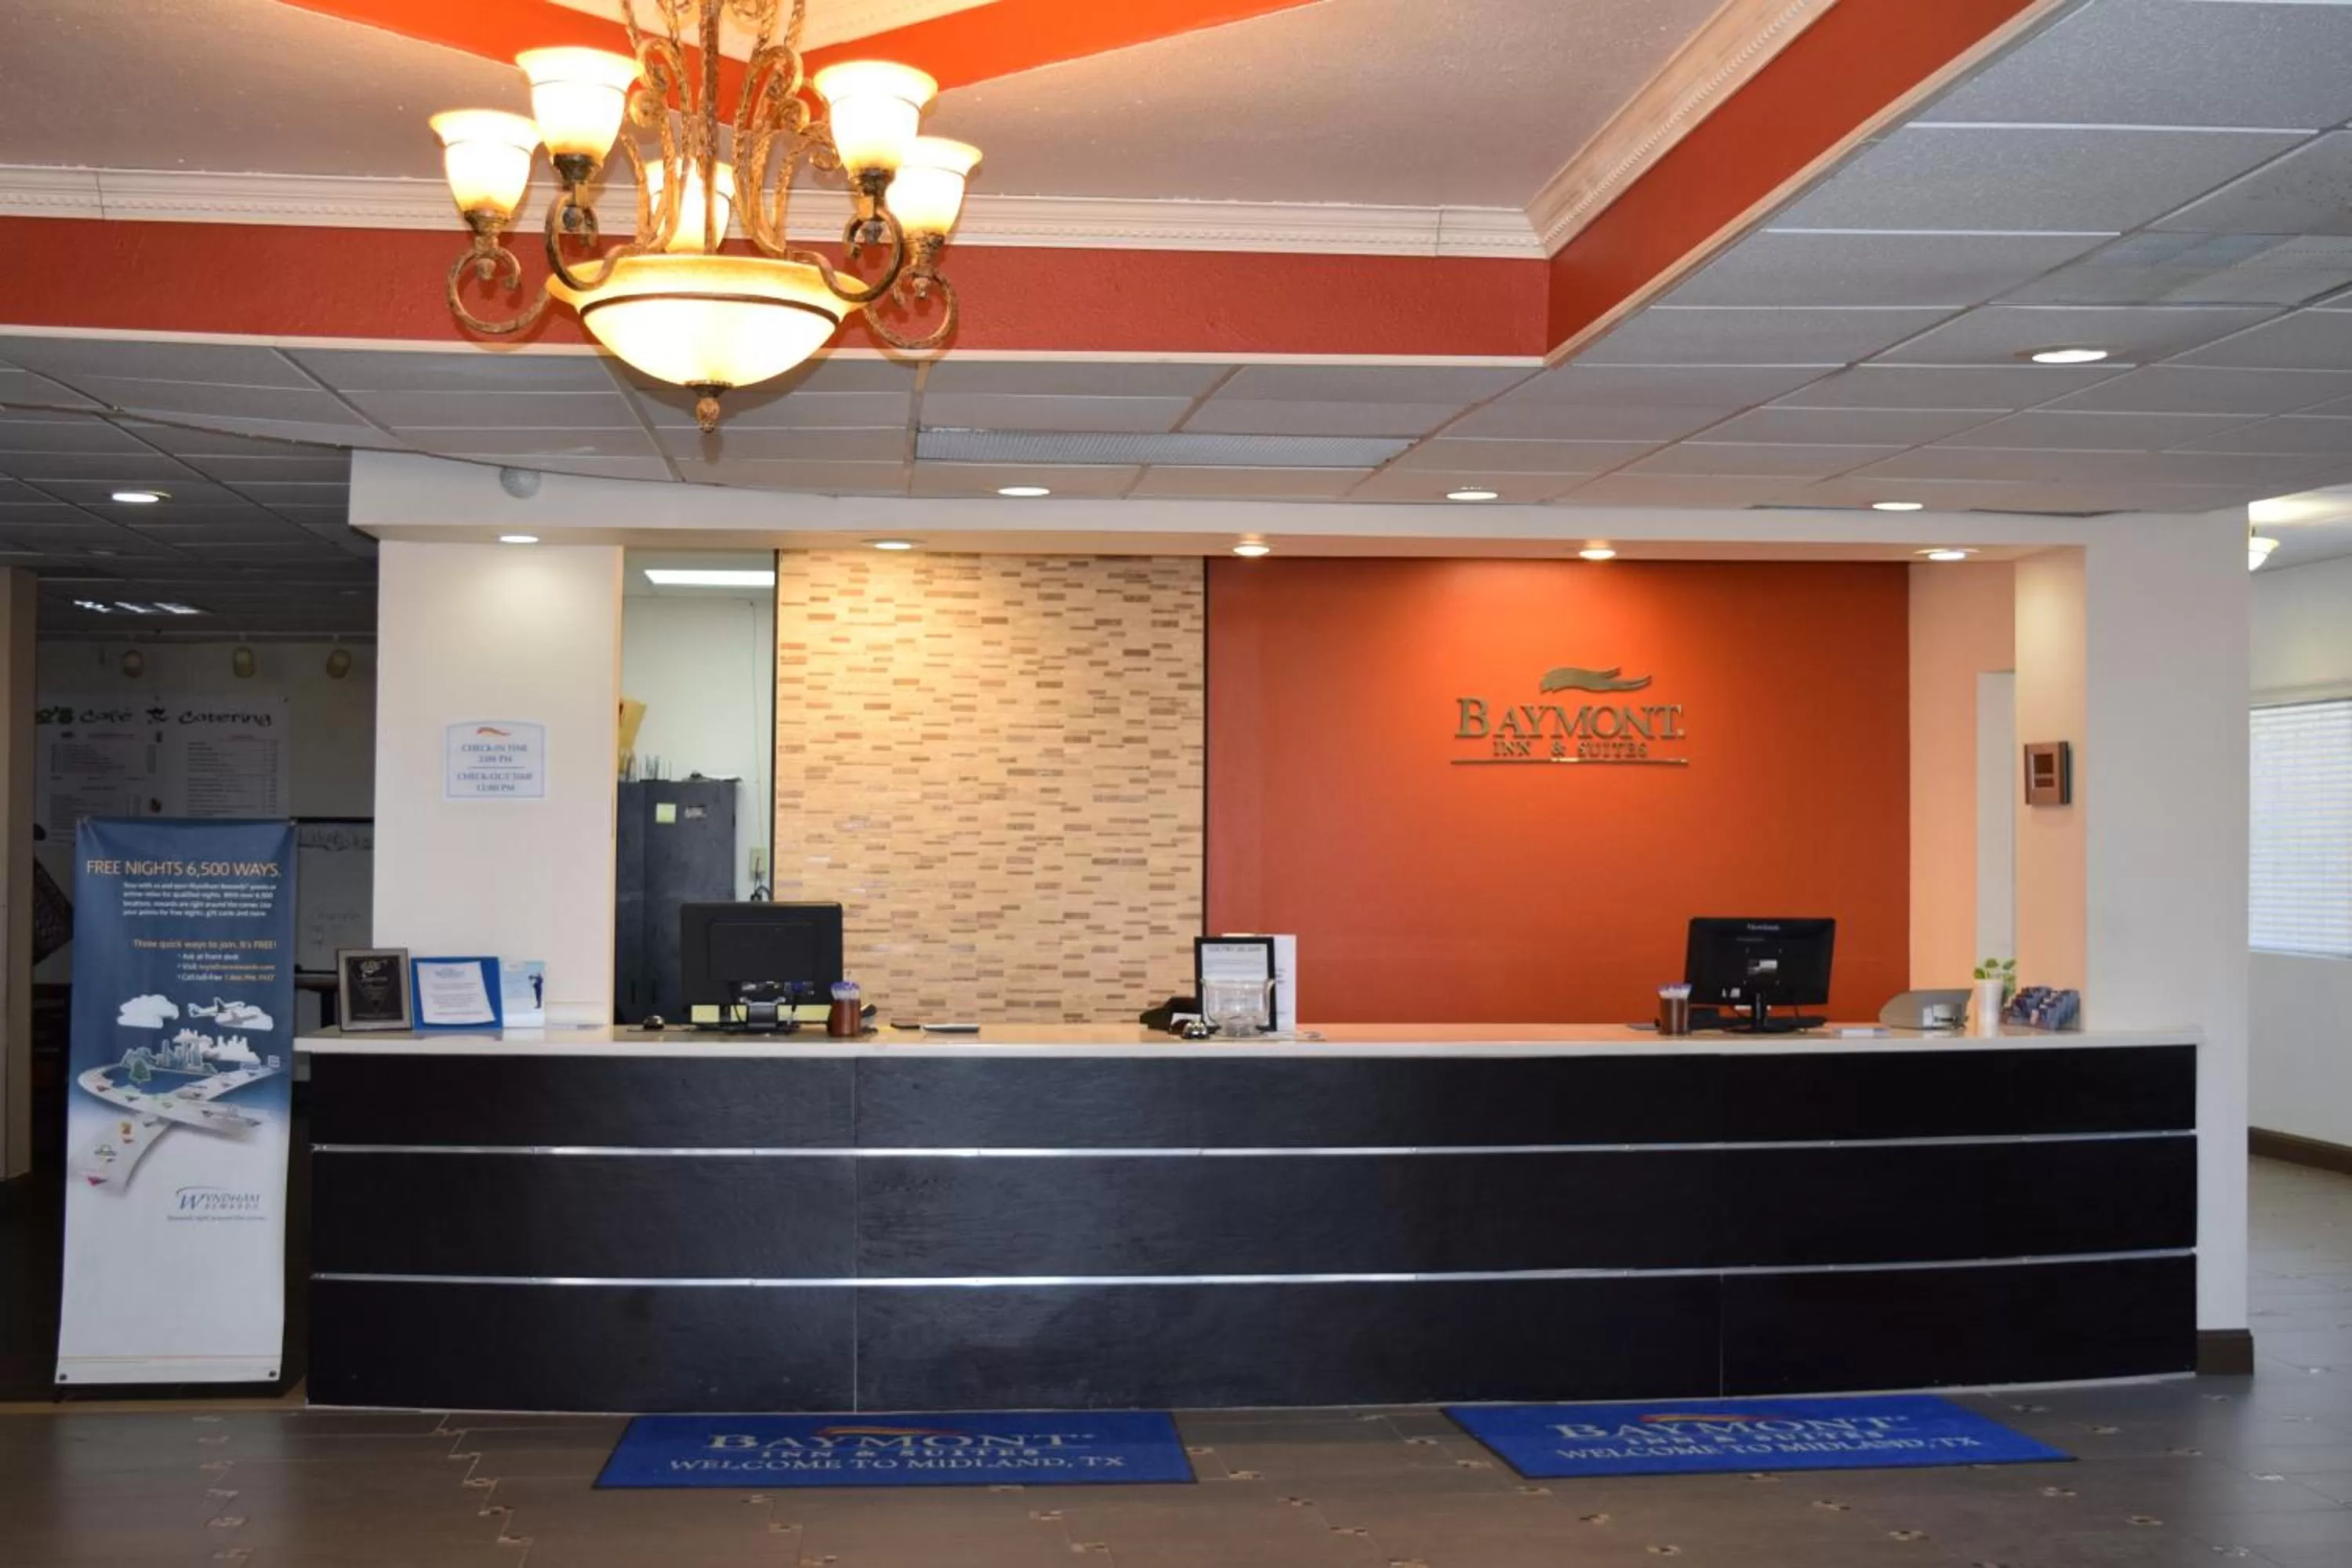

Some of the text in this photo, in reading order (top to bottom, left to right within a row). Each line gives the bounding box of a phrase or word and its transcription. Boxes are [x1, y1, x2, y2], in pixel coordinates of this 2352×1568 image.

[1455, 695, 1682, 739] BAYMONT
[1493, 741, 1647, 758] INN & SUITES
[86, 860, 121, 875] FREE
[125, 861, 183, 877] NIGHTS
[186, 862, 230, 878] 6,500
[179, 1192, 260, 1210] WYNDHAM
[1546, 1417, 1893, 1439] BAYMONT
[706, 1434, 1079, 1449] BAYMONT
[760, 1450, 832, 1458] INN
[898, 1448, 1040, 1457] SUITES
[1555, 1444, 1722, 1459] WELCOME
[1730, 1443, 1773, 1454] TO
[670, 1458, 842, 1471] WELCOME
[848, 1458, 898, 1470] TO
[1078, 1456, 1127, 1467] TX
